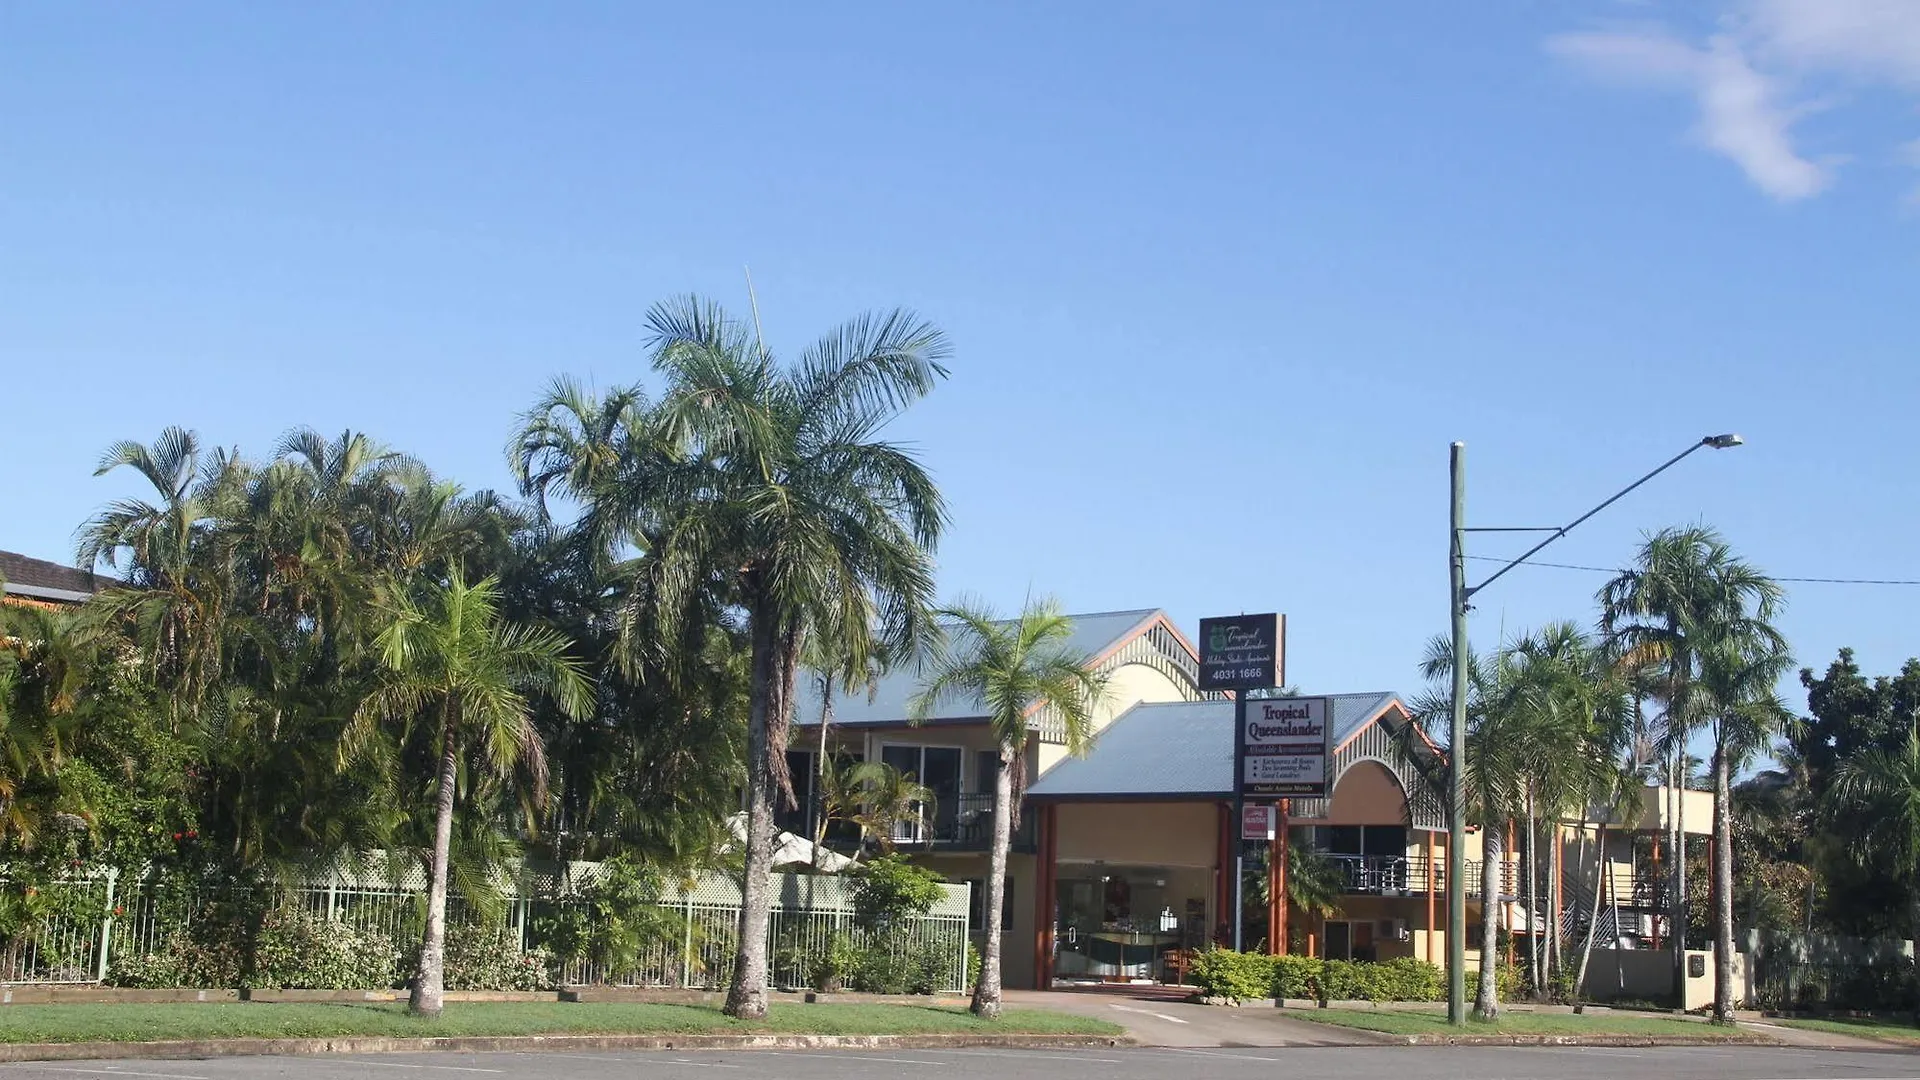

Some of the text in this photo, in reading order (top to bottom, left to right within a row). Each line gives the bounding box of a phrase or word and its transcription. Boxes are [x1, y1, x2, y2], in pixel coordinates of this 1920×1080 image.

[1213, 667, 1262, 680] 4031 1666
[1262, 703, 1310, 724] Tropical
[1249, 720, 1323, 741] Queenslander
